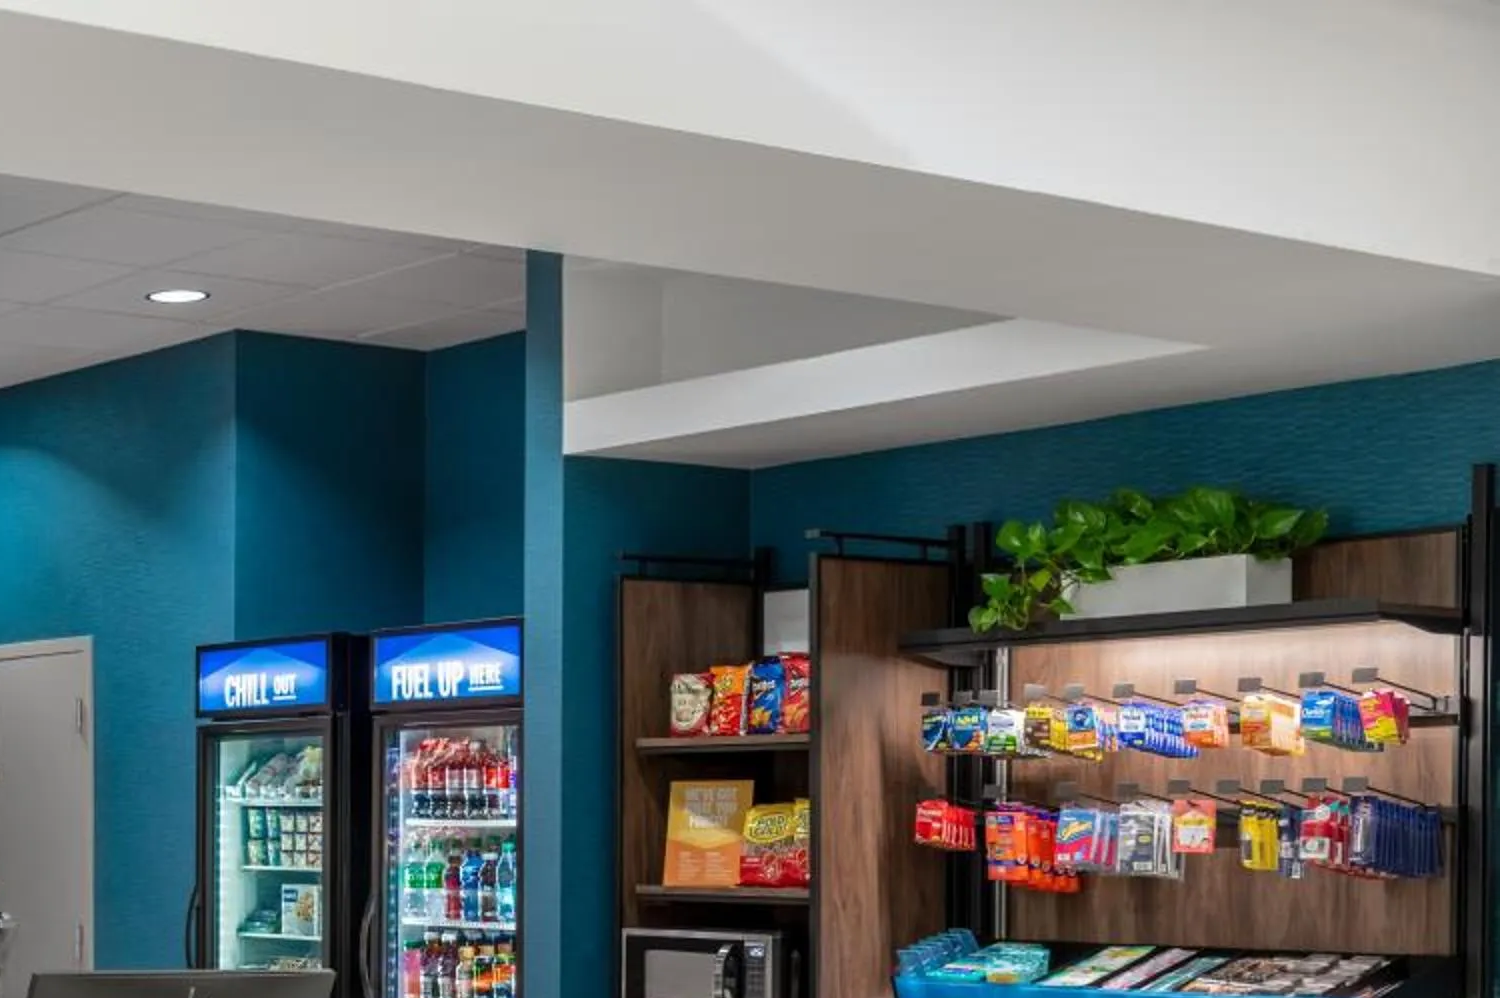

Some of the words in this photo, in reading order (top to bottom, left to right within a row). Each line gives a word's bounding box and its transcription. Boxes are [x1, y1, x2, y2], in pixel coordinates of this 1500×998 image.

[224, 672, 270, 708] CHILL
[273, 672, 297, 695] OUT
[391, 662, 434, 700] FUEL
[438, 660, 464, 697] UP
[468, 663, 502, 686] HERE
